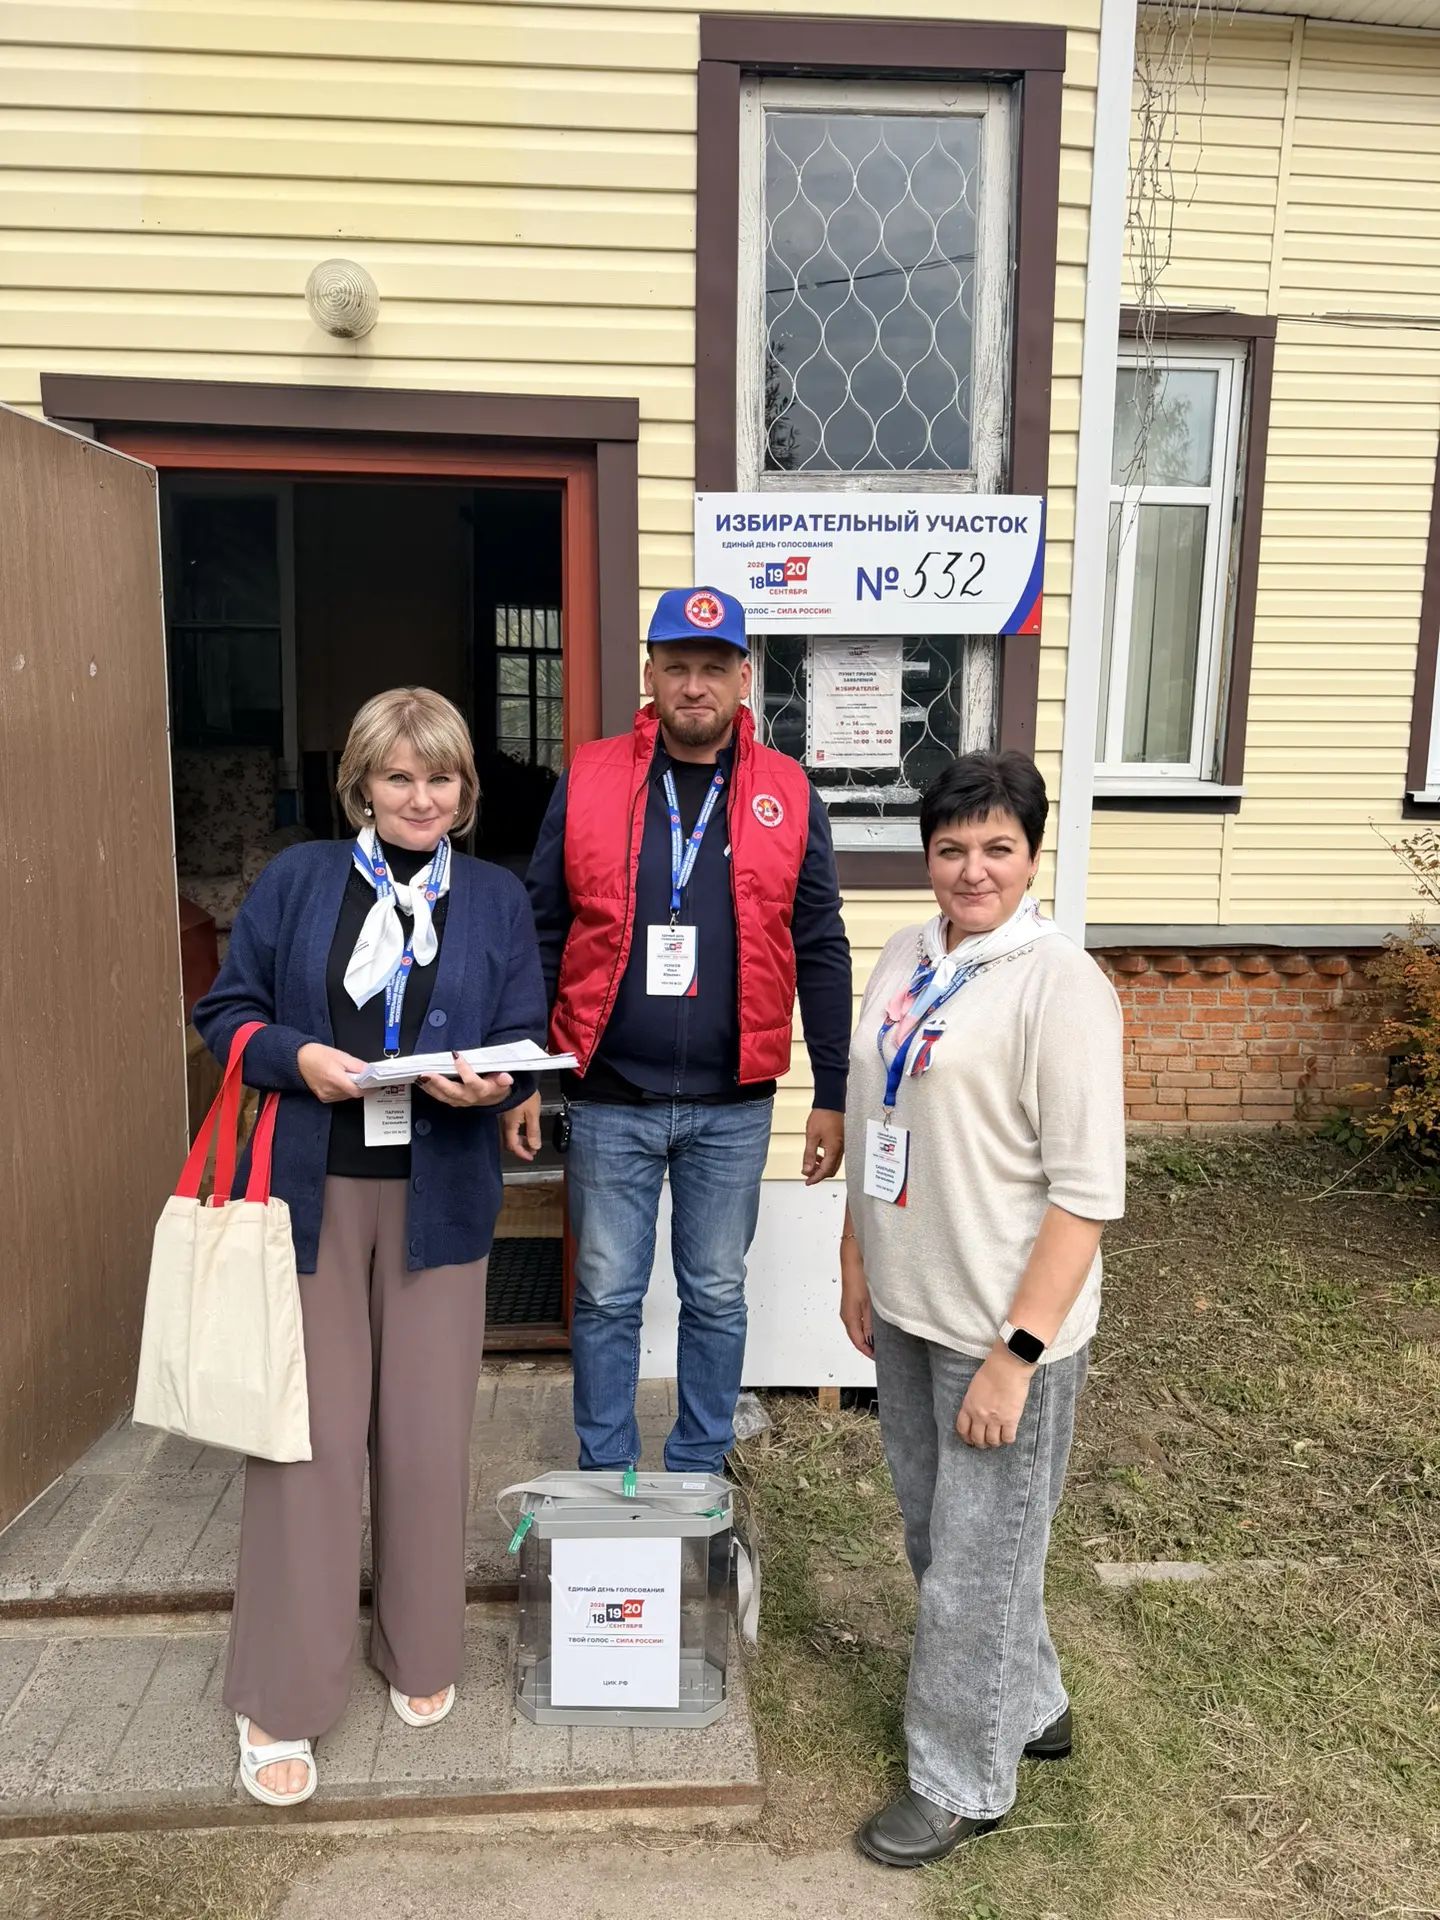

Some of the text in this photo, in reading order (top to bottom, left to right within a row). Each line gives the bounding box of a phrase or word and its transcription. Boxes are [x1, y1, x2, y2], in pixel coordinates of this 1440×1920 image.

[716, 510, 1028, 534] ИЗБИРАТЕЛЬНЫЙ УЧАСТОК
[722, 540, 755, 549] ЕДИНЫЙ
[756, 541, 776, 549] ДЕНЬ
[749, 562, 806, 590] 18 19 20
[857, 552, 986, 601] № 532
[592, 1604, 641, 1624] 18 19 20
